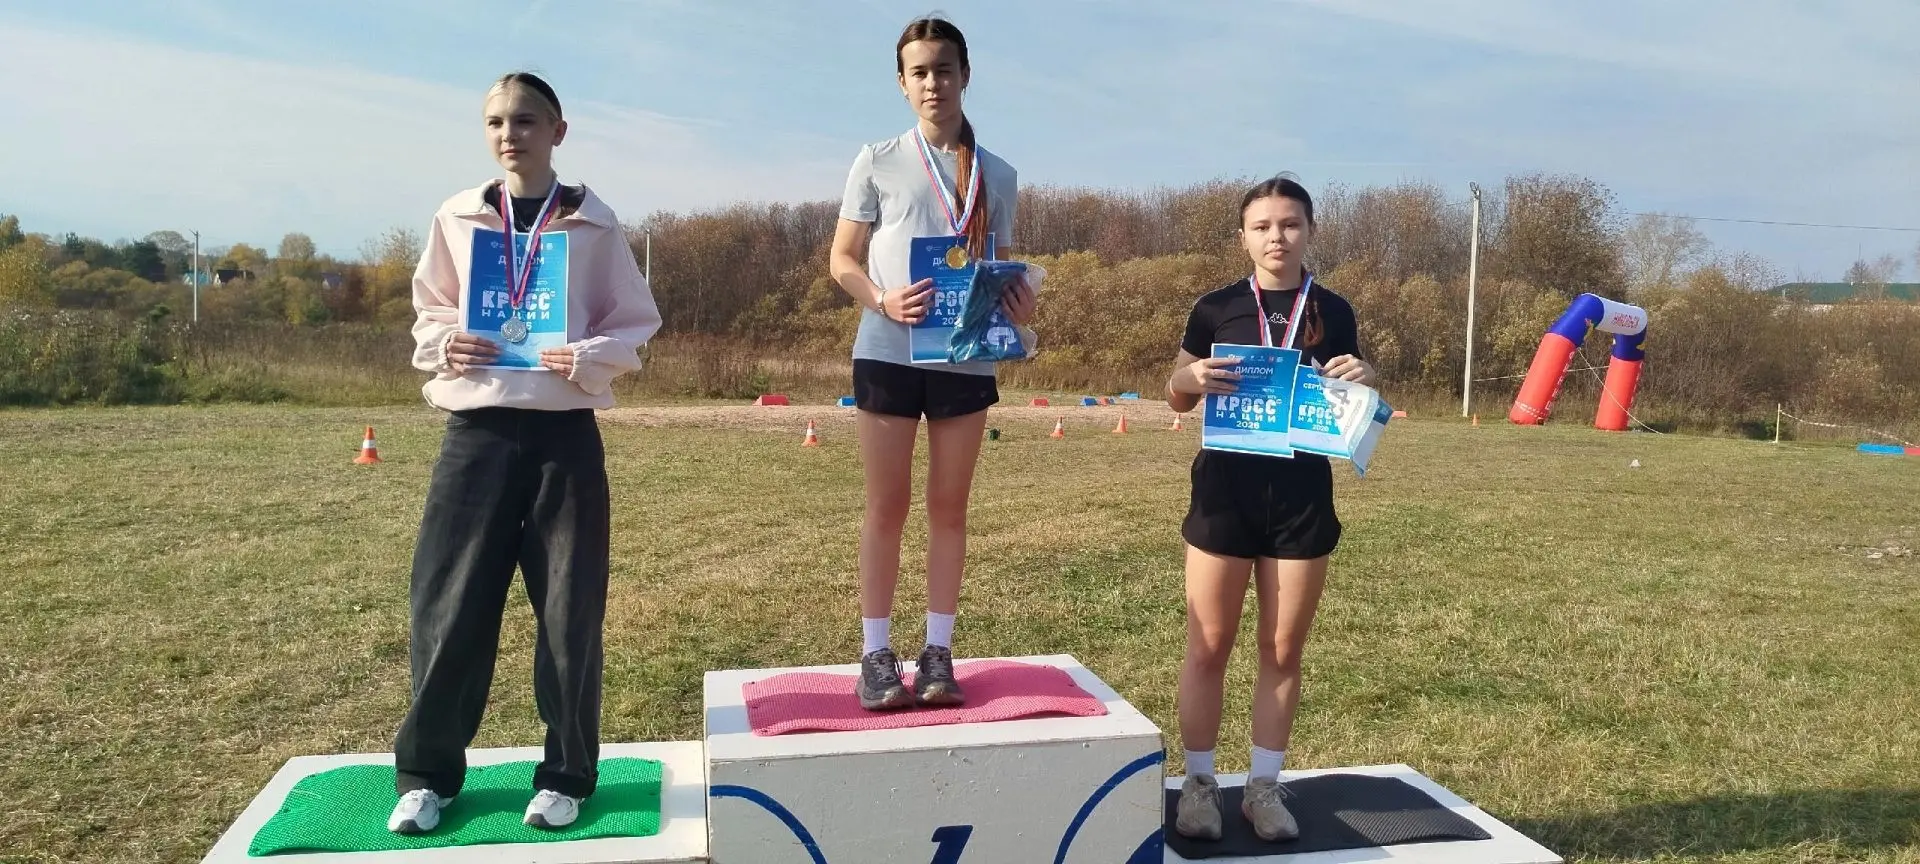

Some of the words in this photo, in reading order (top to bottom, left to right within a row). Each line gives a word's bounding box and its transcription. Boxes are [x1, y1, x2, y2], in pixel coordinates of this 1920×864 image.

[1234, 366, 1274, 376] ДИПЛОМ
[1216, 395, 1277, 415] КРОСС
[1216, 411, 1276, 424] НАЦИИ
